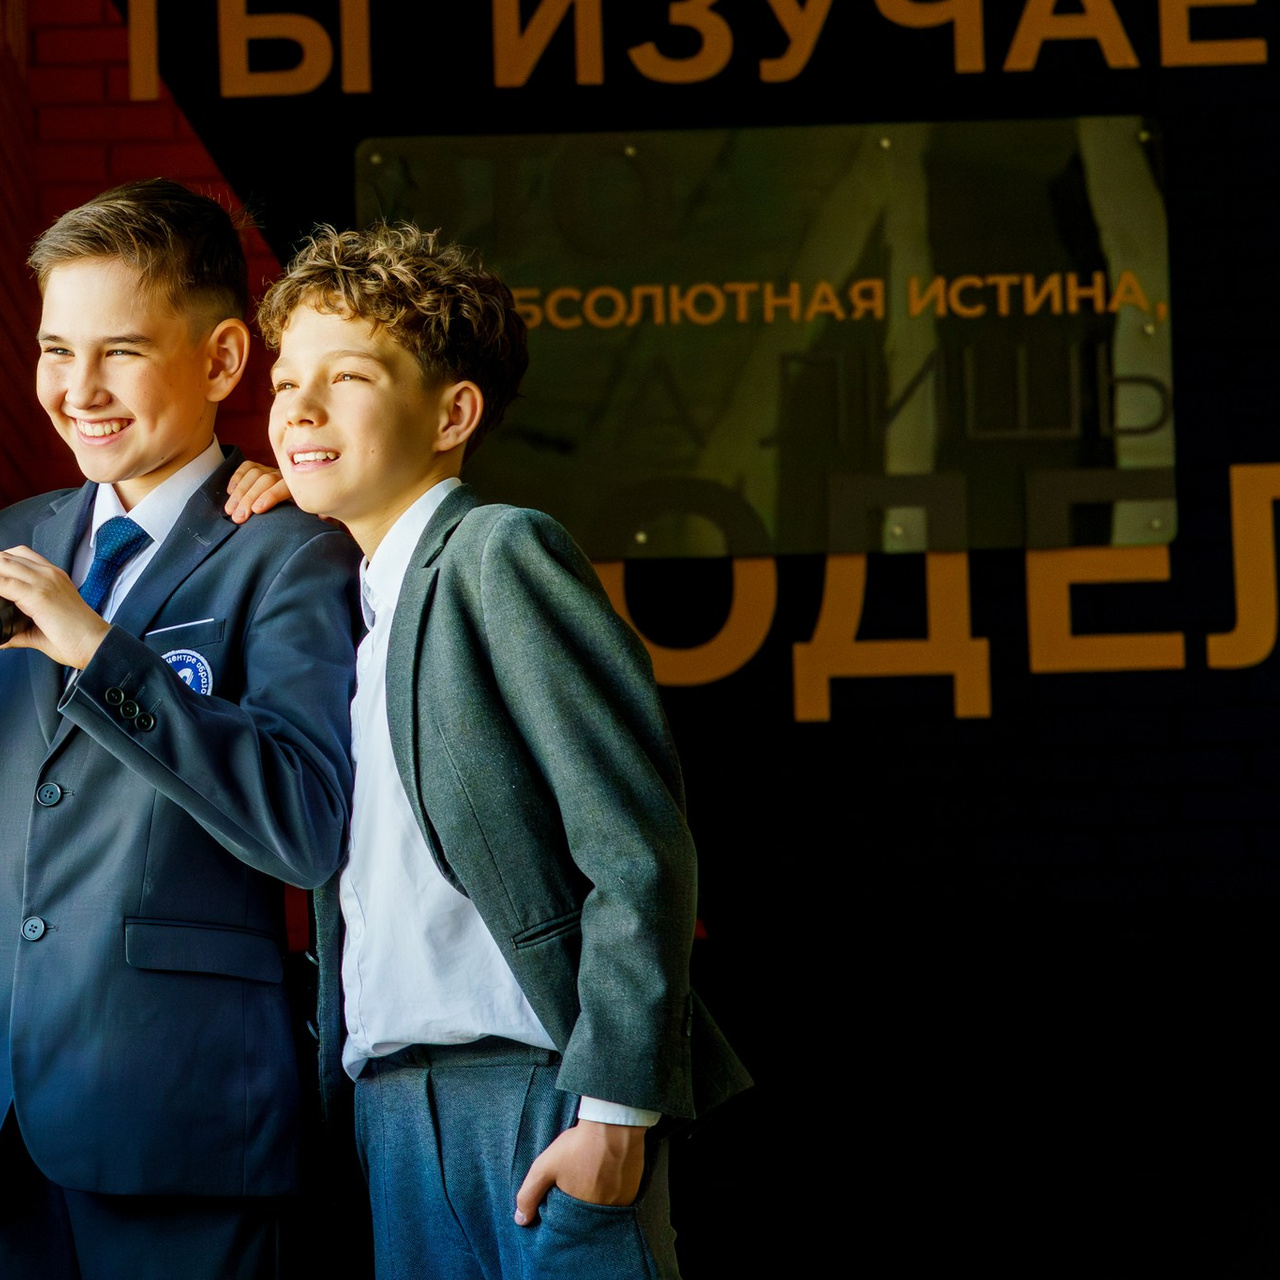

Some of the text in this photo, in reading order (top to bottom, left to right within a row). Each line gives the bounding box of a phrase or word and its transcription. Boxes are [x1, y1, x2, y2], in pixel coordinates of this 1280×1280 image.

[906, 268, 1169, 325] ИСТИНА,
[166, 654, 208, 695] центре образо
